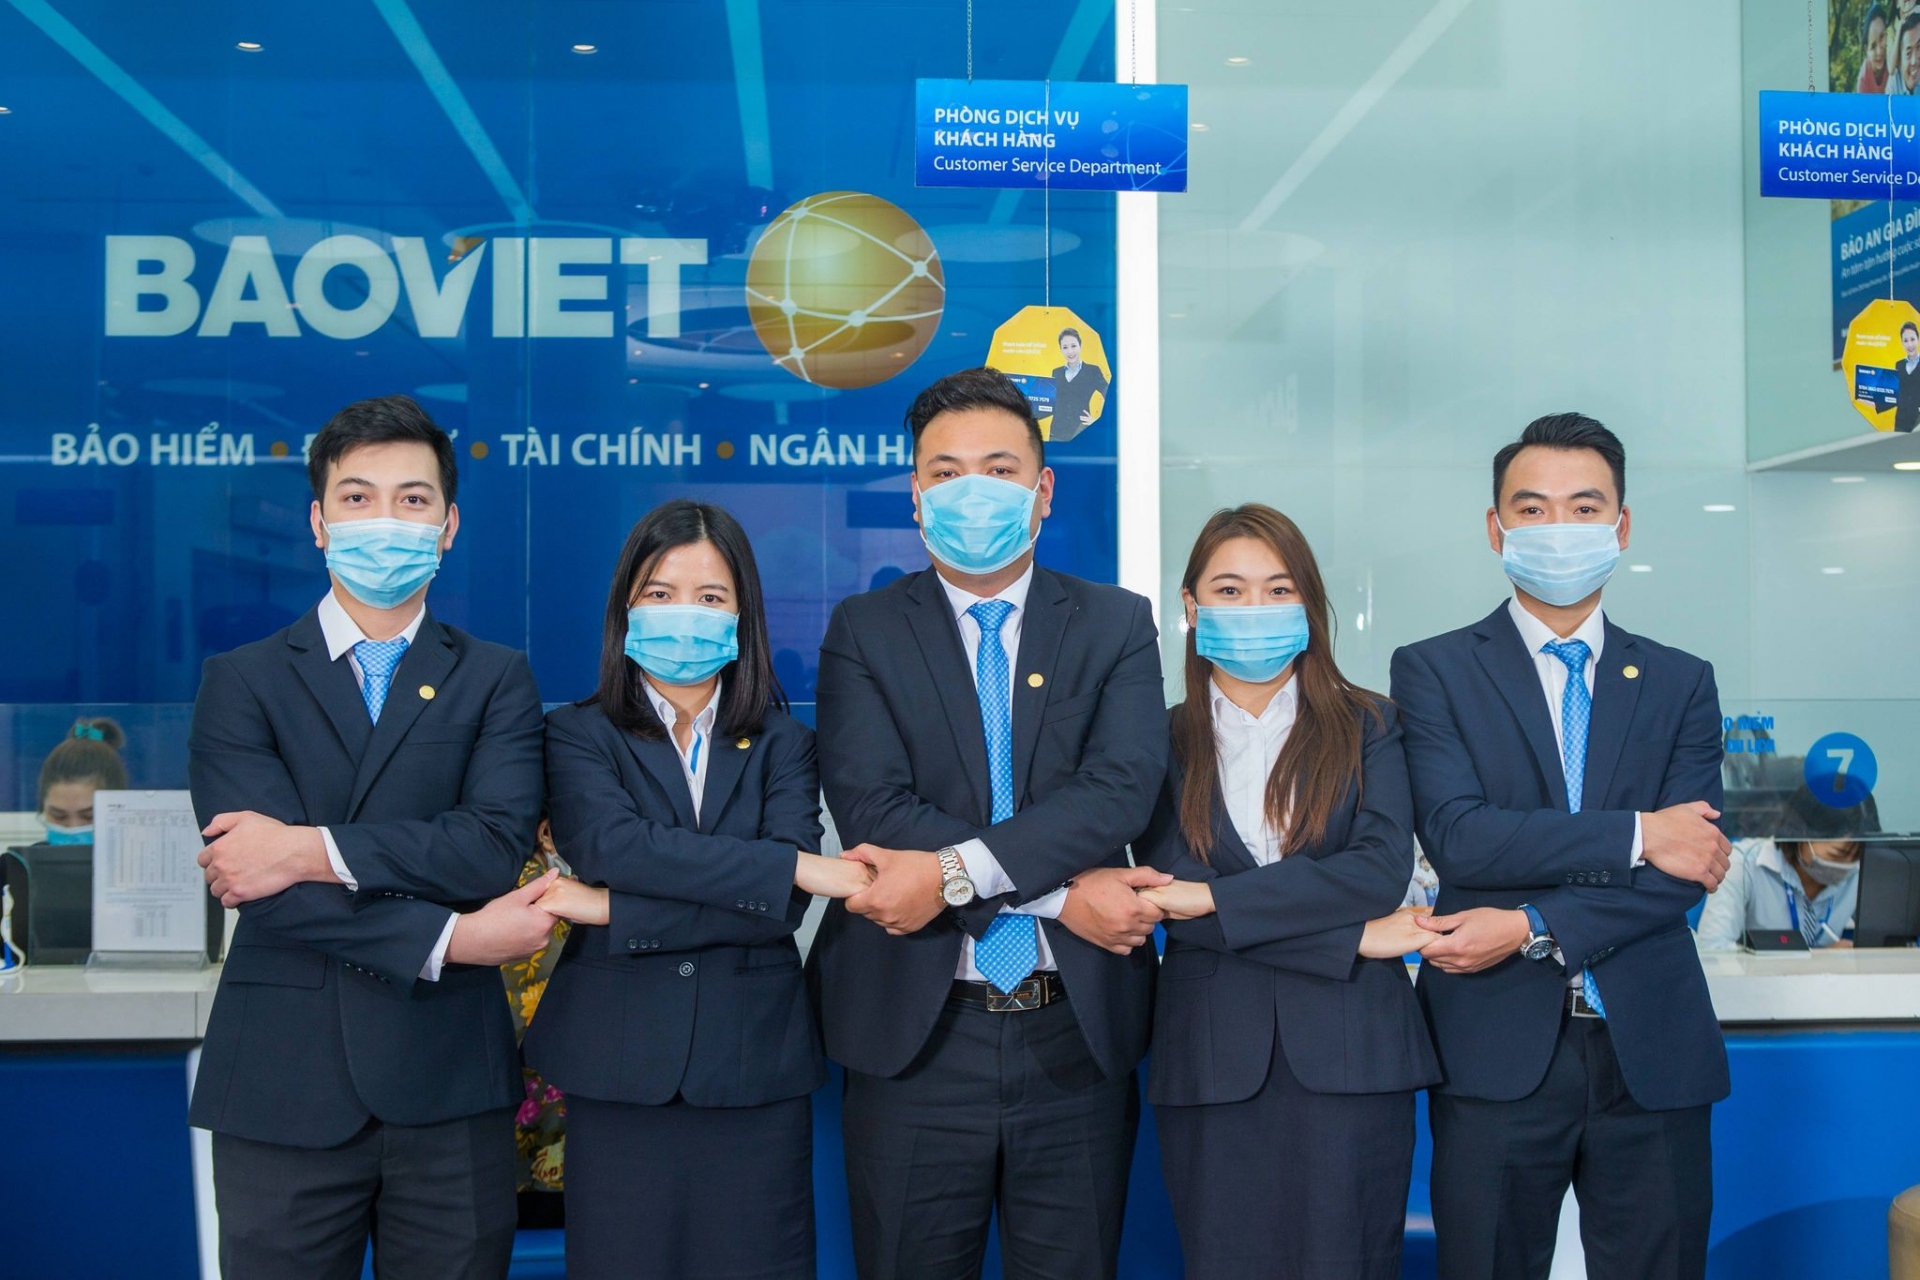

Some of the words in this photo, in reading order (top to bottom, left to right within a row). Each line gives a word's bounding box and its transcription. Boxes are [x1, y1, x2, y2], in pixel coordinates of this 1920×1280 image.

[934, 106, 1000, 125] PHÒNG
[1005, 109, 1049, 128] DỊCH
[1054, 111, 1080, 130] VỤ
[934, 127, 998, 147] KHÁCH
[1003, 129, 1056, 148] HÀNG
[1779, 118, 1841, 136] PHÒNG
[1845, 122, 1887, 141] DỊCH
[1891, 124, 1916, 143] VỤ
[1778, 140, 1839, 159] KHÁCH
[1843, 142, 1894, 161] HÀNG
[933, 155, 1008, 172] Customer
[1011, 157, 1066, 174] Service
[1069, 158, 1162, 177] Department
[1778, 166, 1849, 182] Customer
[1852, 169, 1903, 185] Service
[1865, 226, 1882, 251] AN
[1883, 217, 1904, 242] GIA
[104, 233, 709, 341] BAOVIET
[51, 423, 139, 466] BẢO
[151, 422, 256, 466] HIỂM
[500, 426, 560, 466] TÀI
[572, 425, 701, 466] CHÍNH
[749, 427, 867, 466] NGÂN
[1826, 748, 1855, 793] 7
